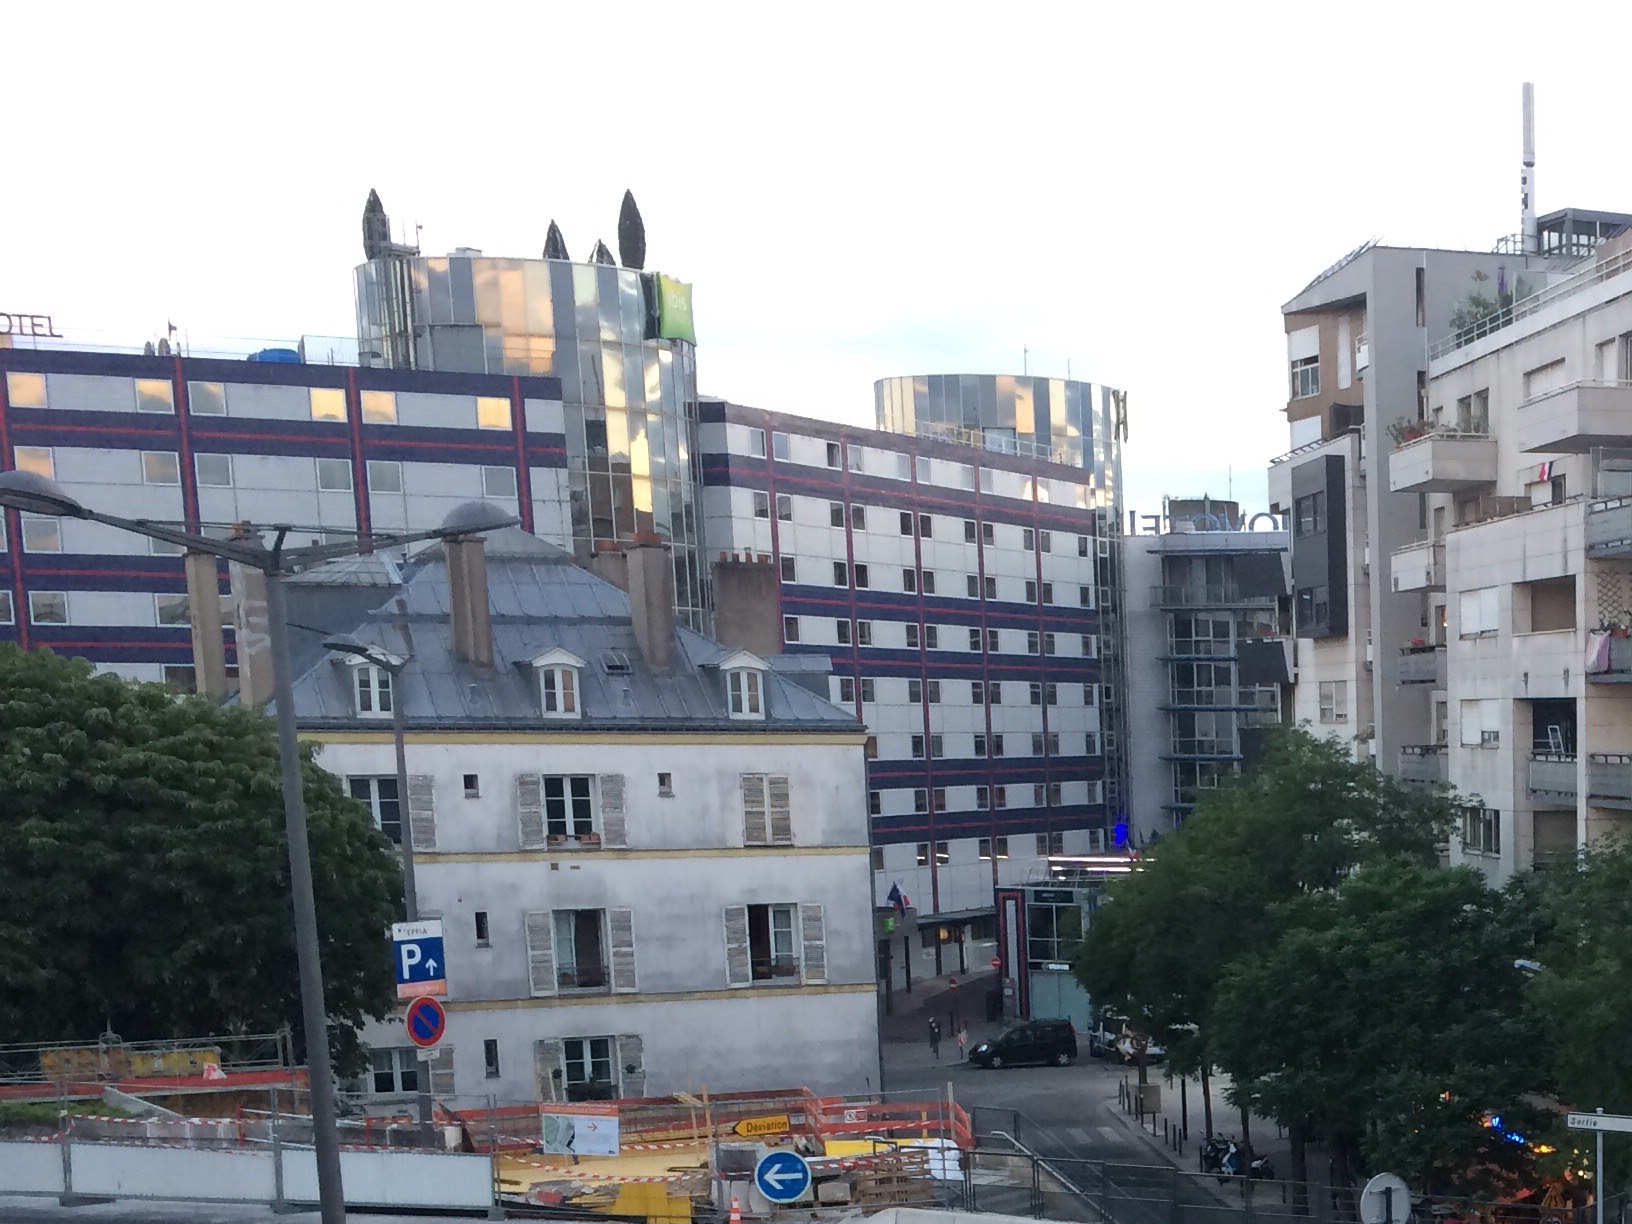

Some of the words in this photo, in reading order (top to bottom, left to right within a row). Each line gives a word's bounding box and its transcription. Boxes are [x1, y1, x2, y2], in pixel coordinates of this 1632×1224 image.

[400, 943, 422, 980] P
[746, 1121, 788, 1133] Déviation
[1570, 1117, 1598, 1127] Sortie
